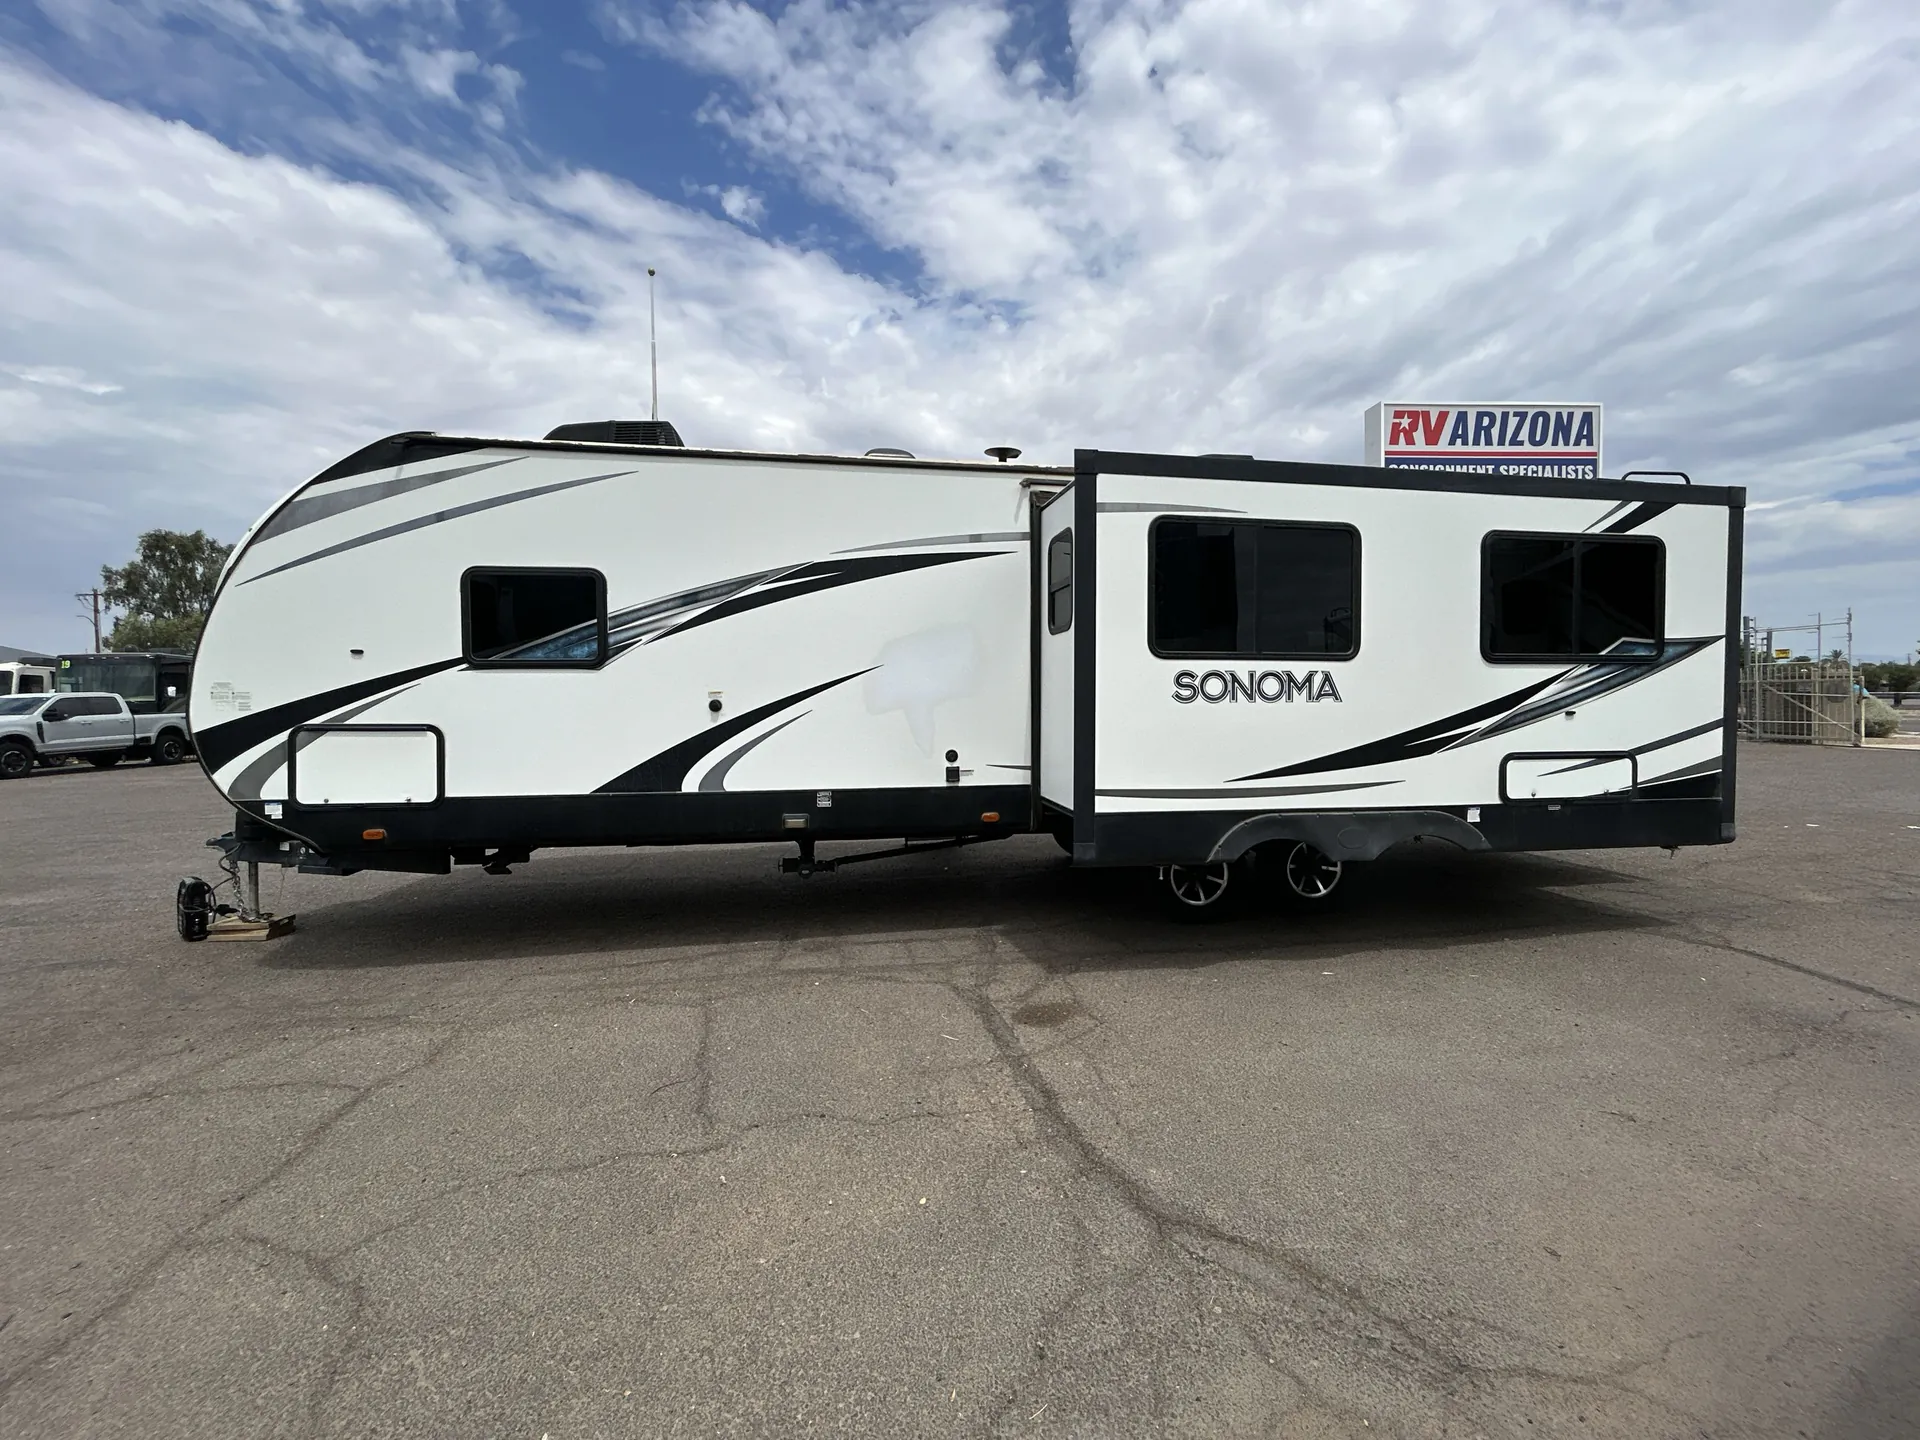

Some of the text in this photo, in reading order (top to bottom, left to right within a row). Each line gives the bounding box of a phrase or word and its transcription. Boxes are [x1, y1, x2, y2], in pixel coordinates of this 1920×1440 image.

[1389, 410, 1594, 447] RV ARIZONA
[1499, 465, 1593, 480] SPECIALISTS
[1172, 669, 1343, 704] SONOMA
